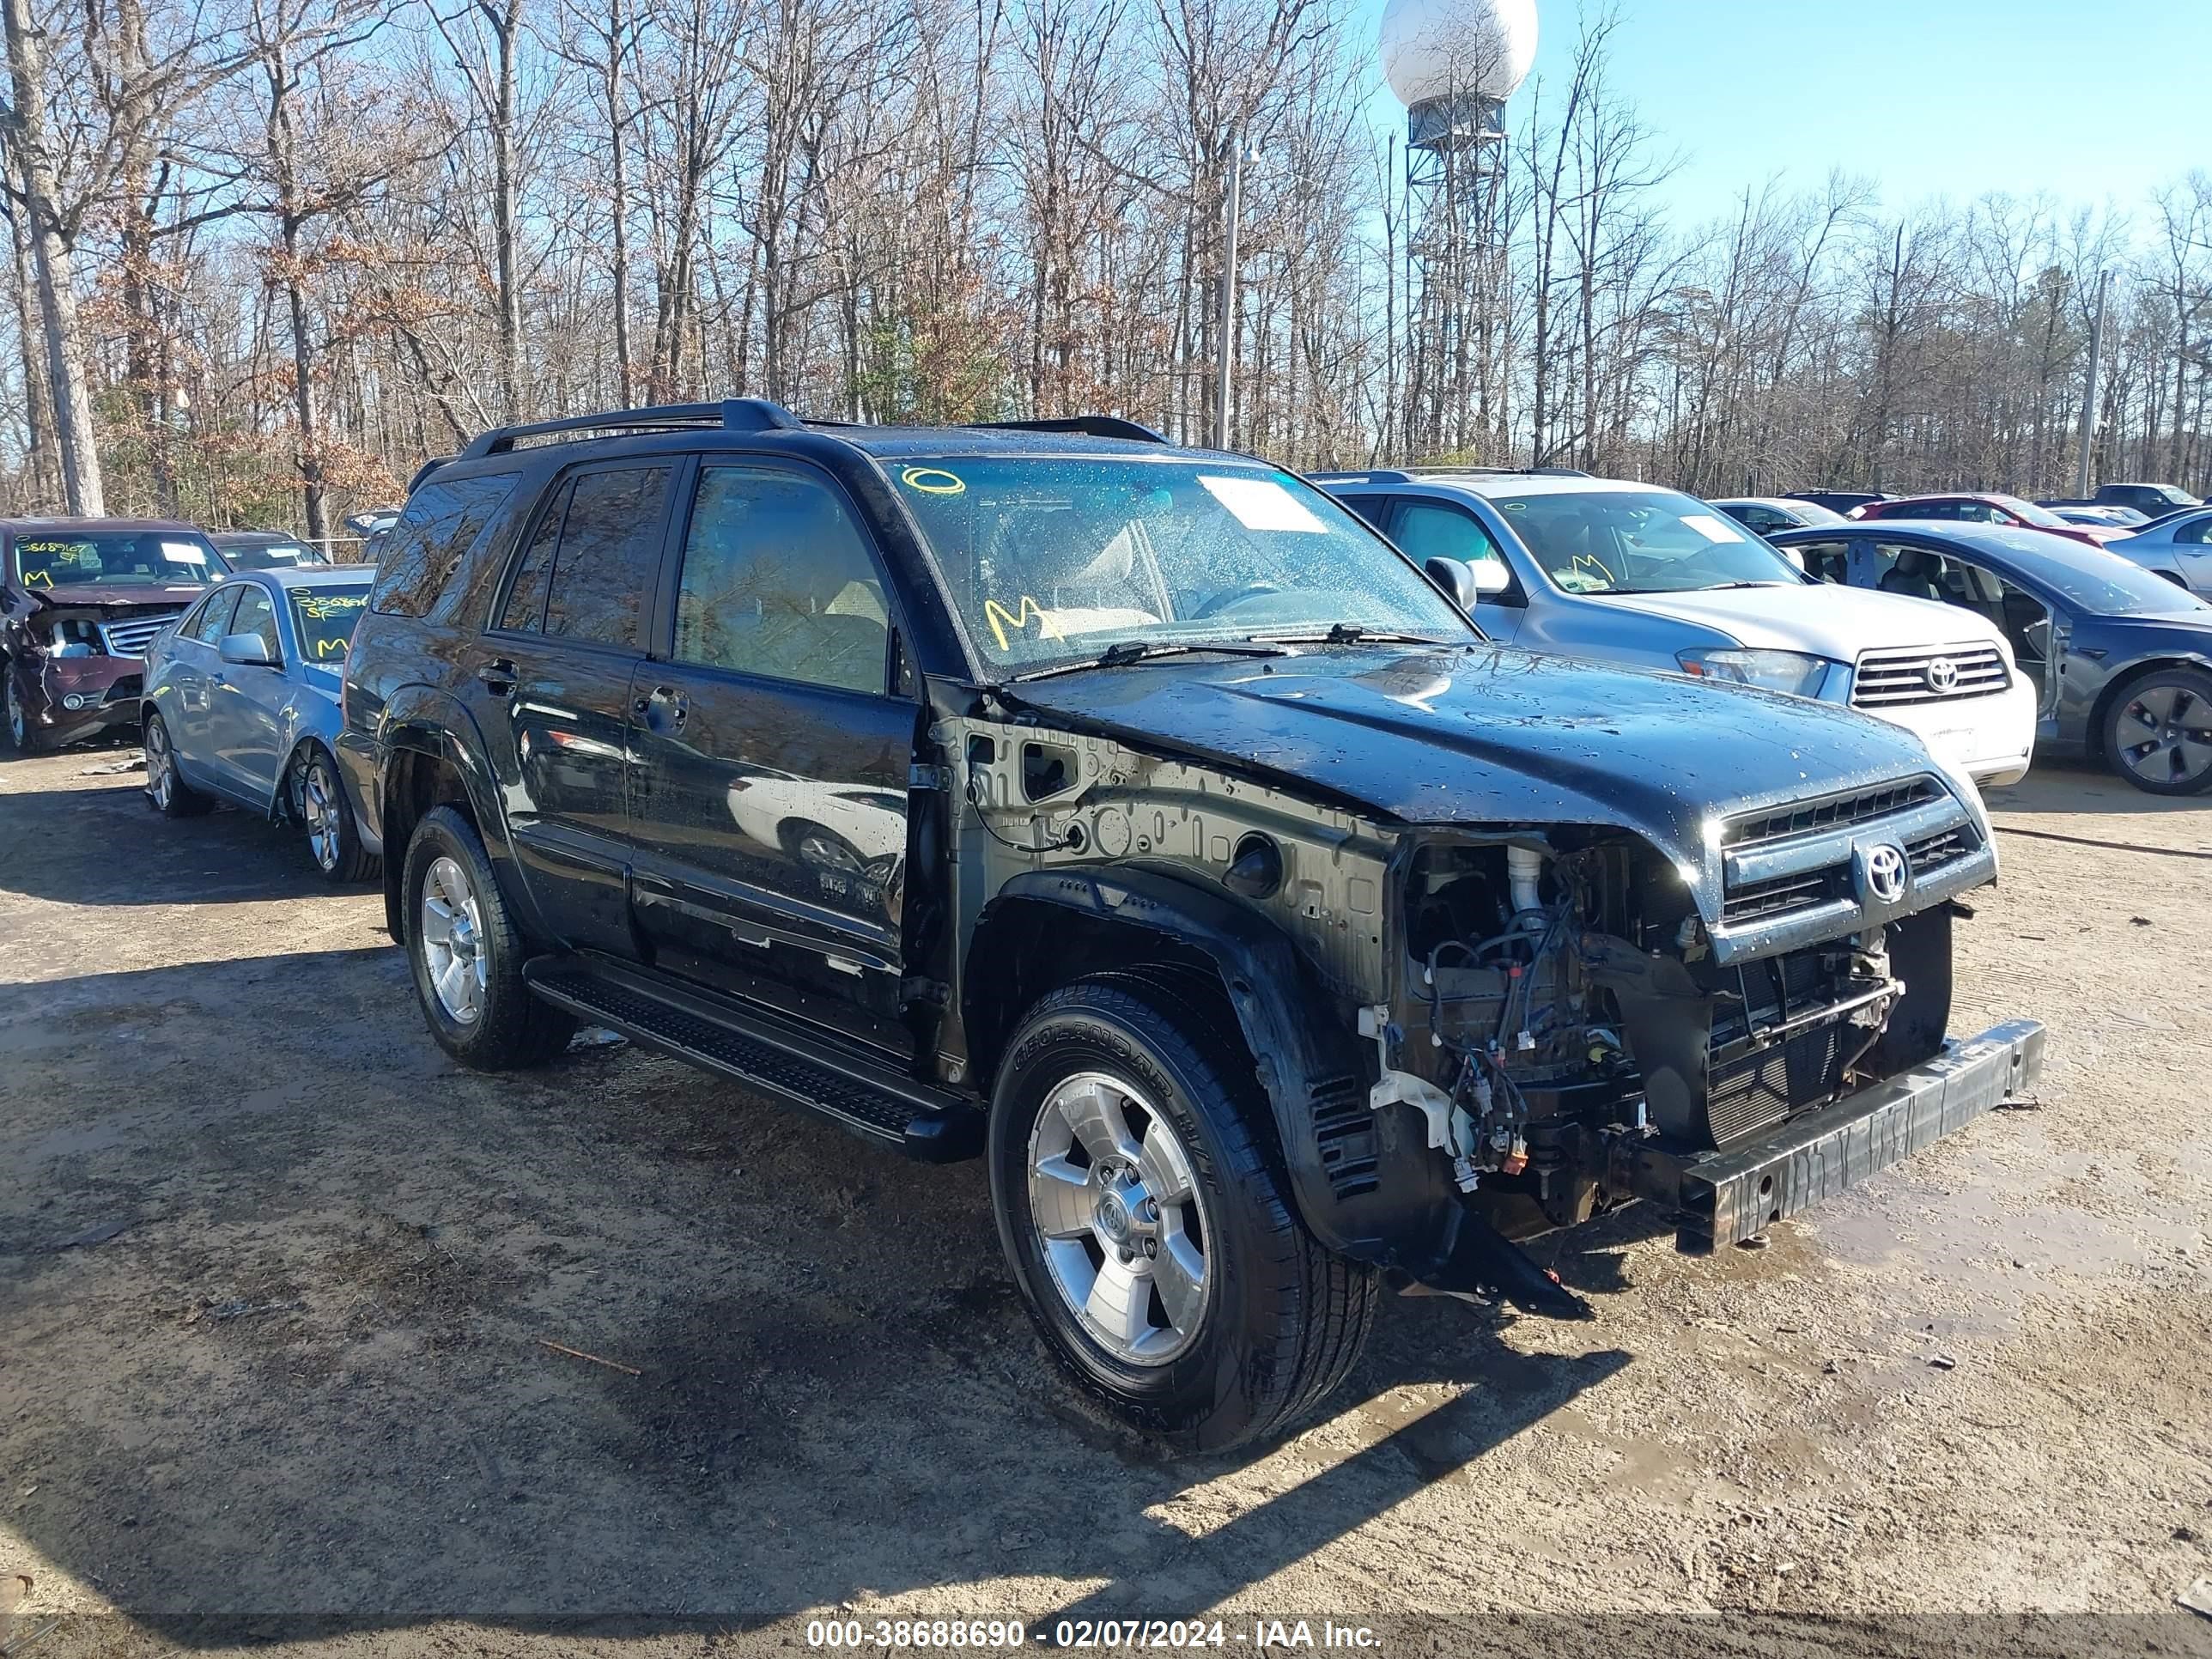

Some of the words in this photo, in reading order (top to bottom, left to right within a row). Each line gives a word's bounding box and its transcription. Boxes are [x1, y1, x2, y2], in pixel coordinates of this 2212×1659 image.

[24, 568, 54, 591] M
[1572, 554, 1615, 584] M
[984, 595, 1066, 652] M
[317, 638, 349, 659] M
[1012, 1020, 1174, 1099] GEOLANDAR
